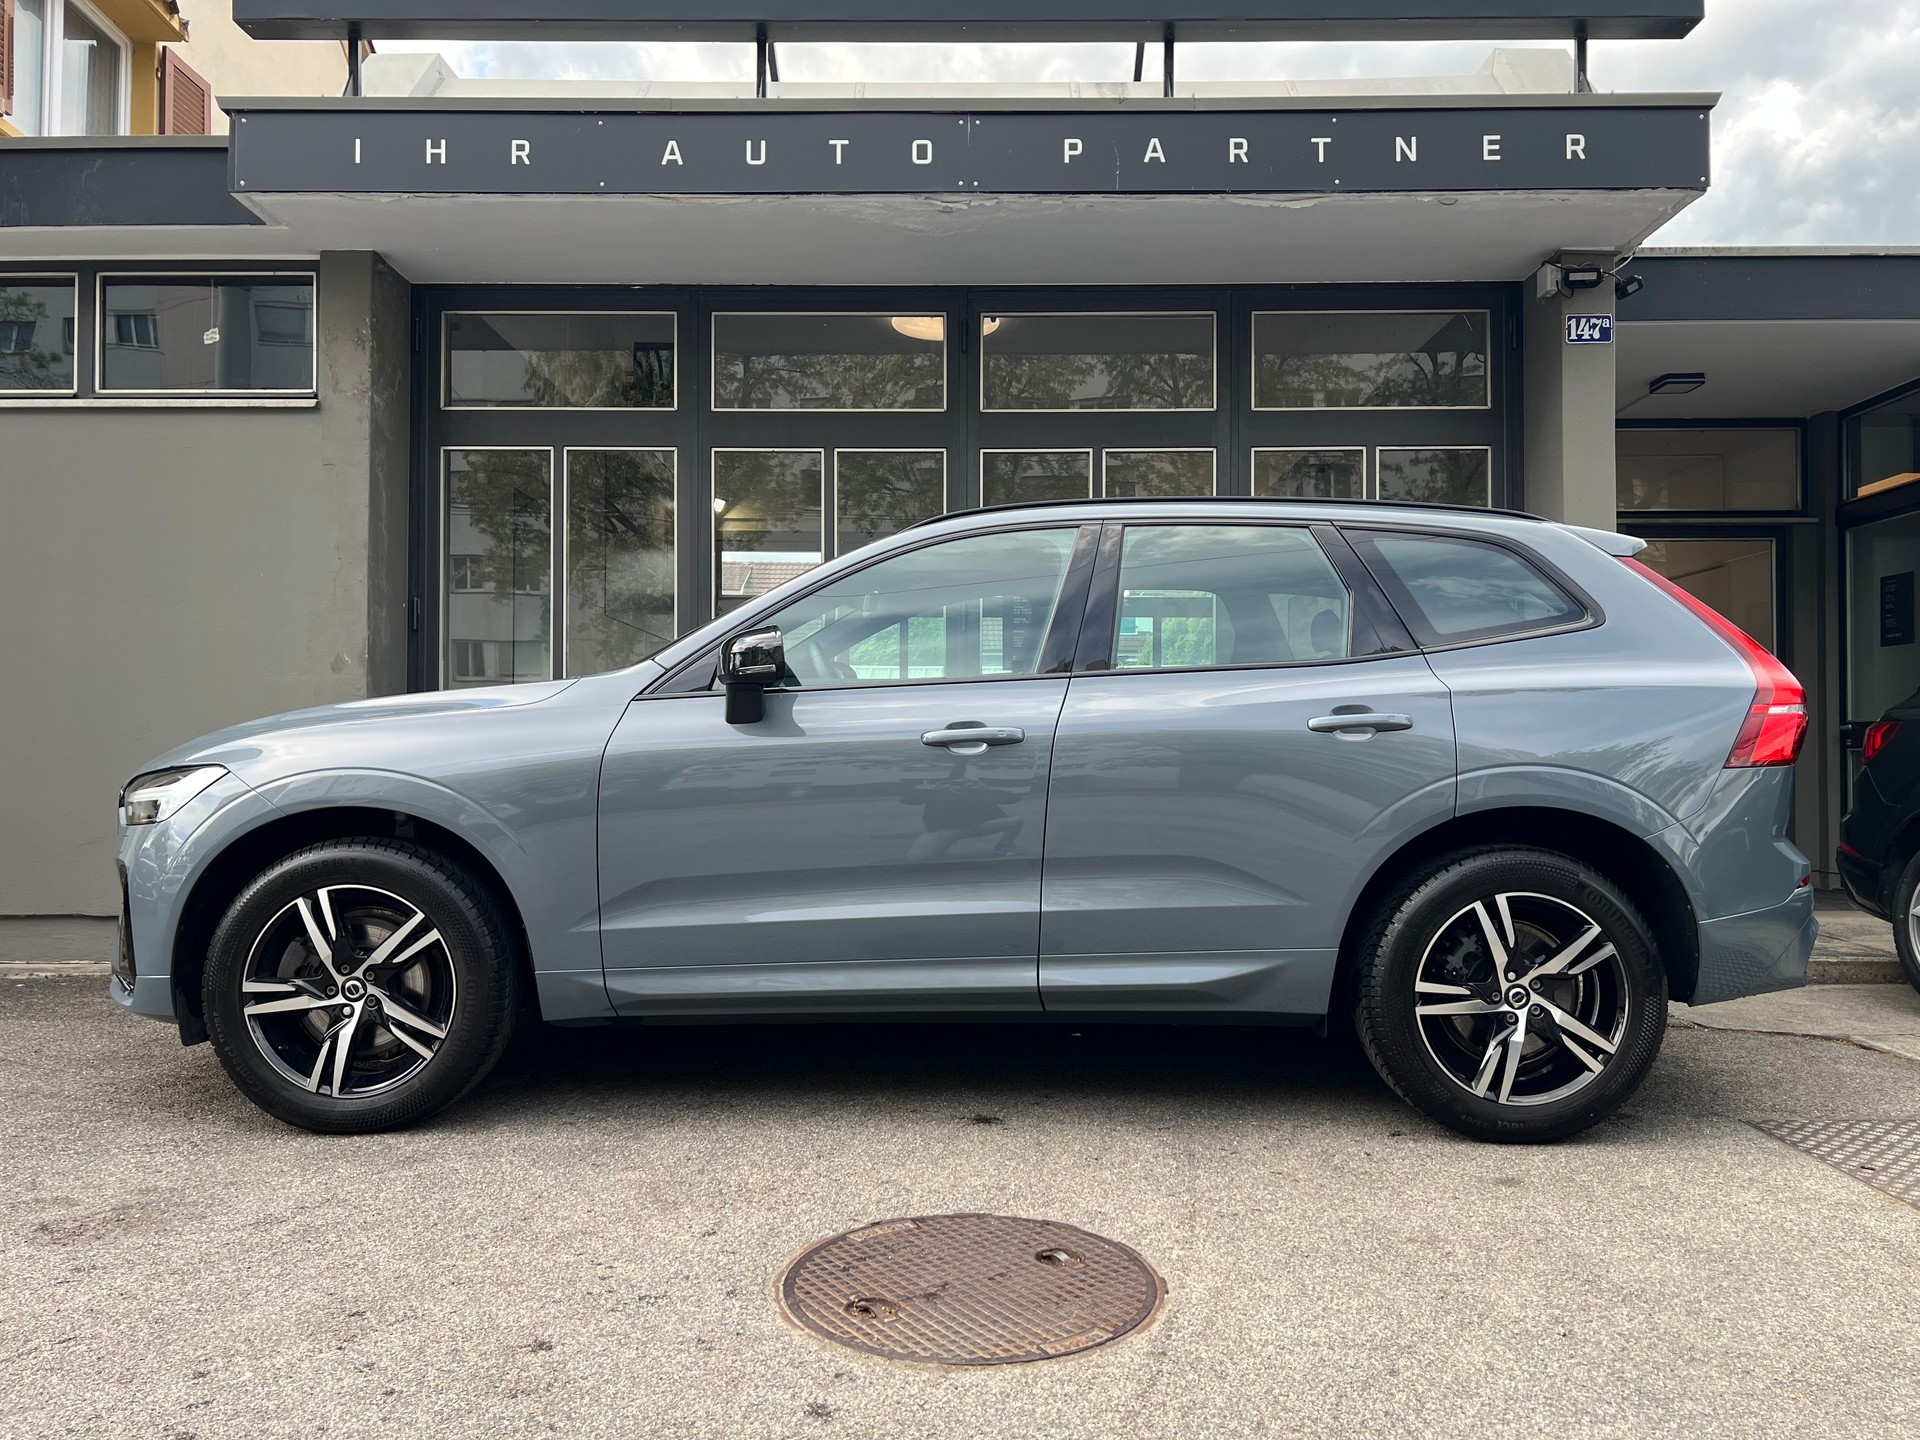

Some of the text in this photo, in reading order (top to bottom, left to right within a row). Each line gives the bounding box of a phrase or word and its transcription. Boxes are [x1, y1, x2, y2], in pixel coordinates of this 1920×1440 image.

[354, 134, 1586, 166] IHR AUTO PARTNER
[1568, 318, 1610, 340] 147a
